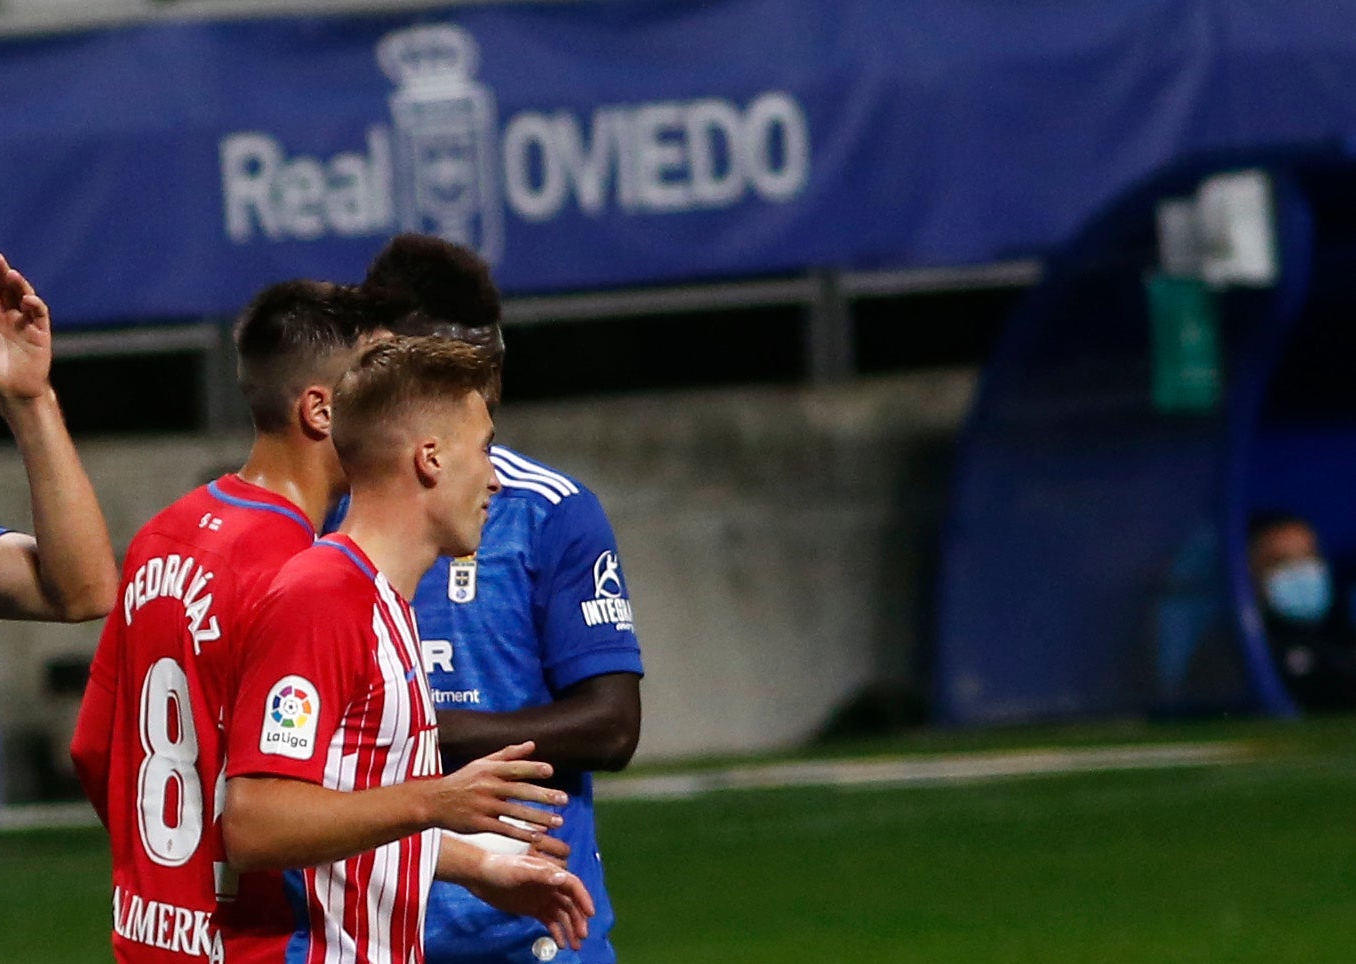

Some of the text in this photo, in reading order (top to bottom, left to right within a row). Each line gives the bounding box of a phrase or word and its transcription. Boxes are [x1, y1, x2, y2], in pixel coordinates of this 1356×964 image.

[220, 90, 809, 243] Real OVIEDO
[137, 657, 203, 867] 8
[266, 731, 308, 748] LaLiga
